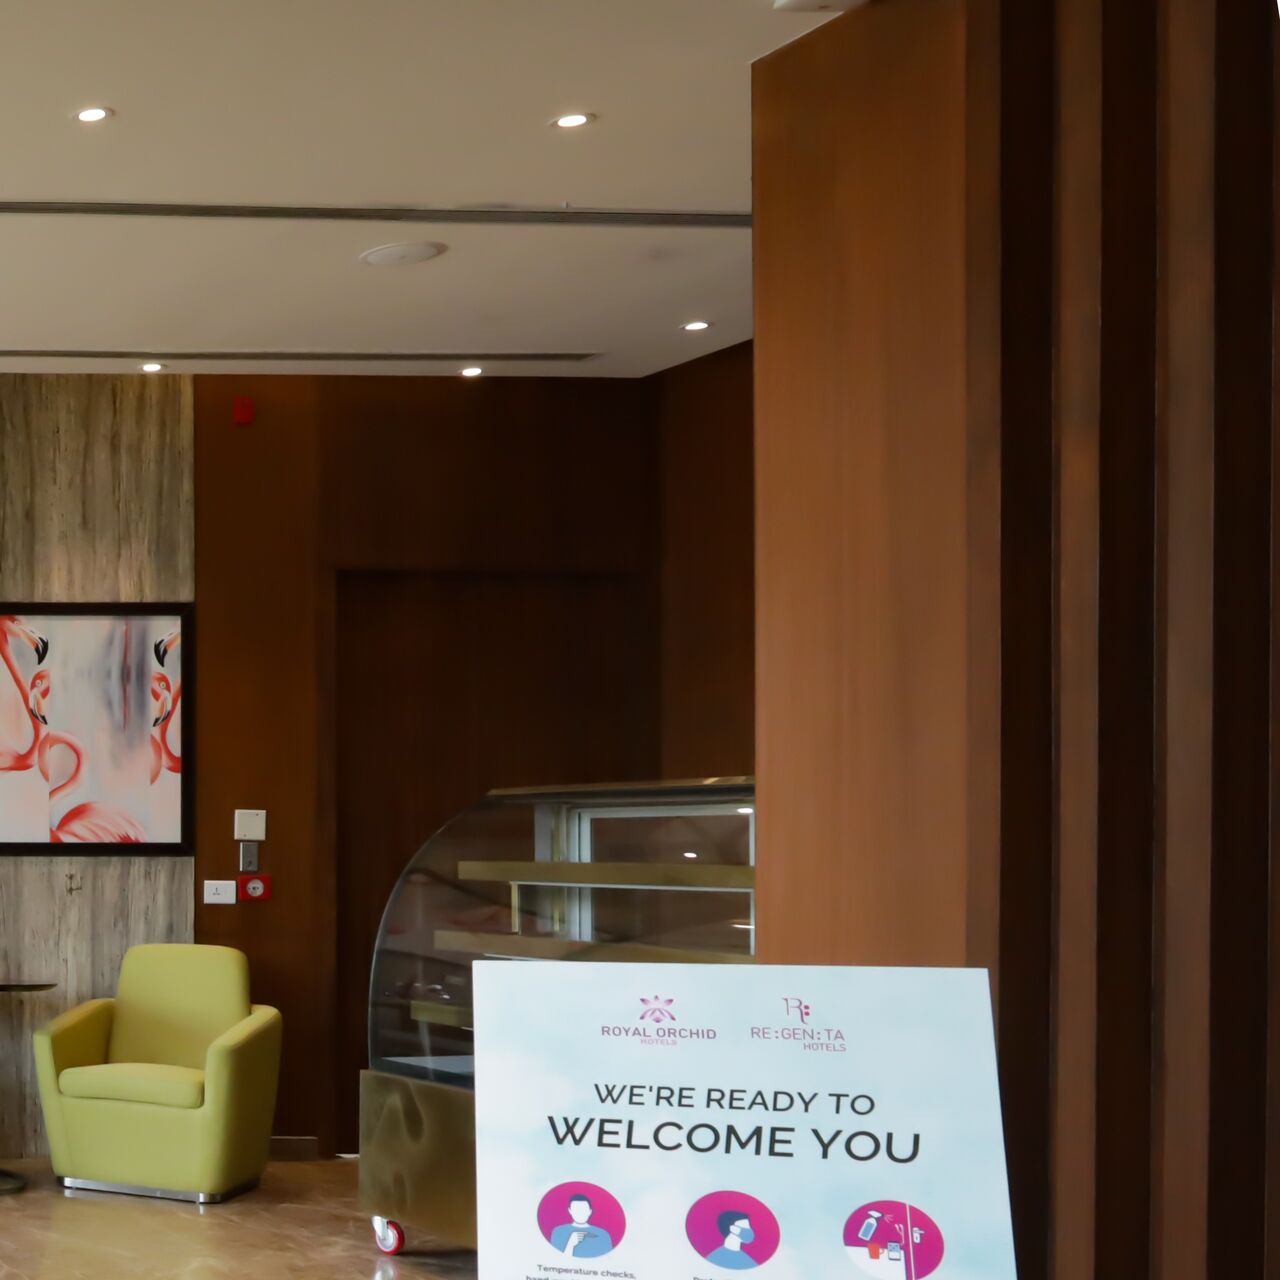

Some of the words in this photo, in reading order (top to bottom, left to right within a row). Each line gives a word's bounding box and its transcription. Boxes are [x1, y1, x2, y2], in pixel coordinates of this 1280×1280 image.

[601, 1026, 651, 1037] ROYAL
[656, 1027, 717, 1039] ORCHID
[803, 1042, 846, 1052] HOTELS
[594, 1083, 696, 1108] WE'RE
[705, 1087, 820, 1114] READY
[828, 1092, 876, 1116] TO
[547, 1115, 797, 1157] WELCOME
[810, 1127, 923, 1164] YOU
[538, 1264, 598, 1275] Temperature
